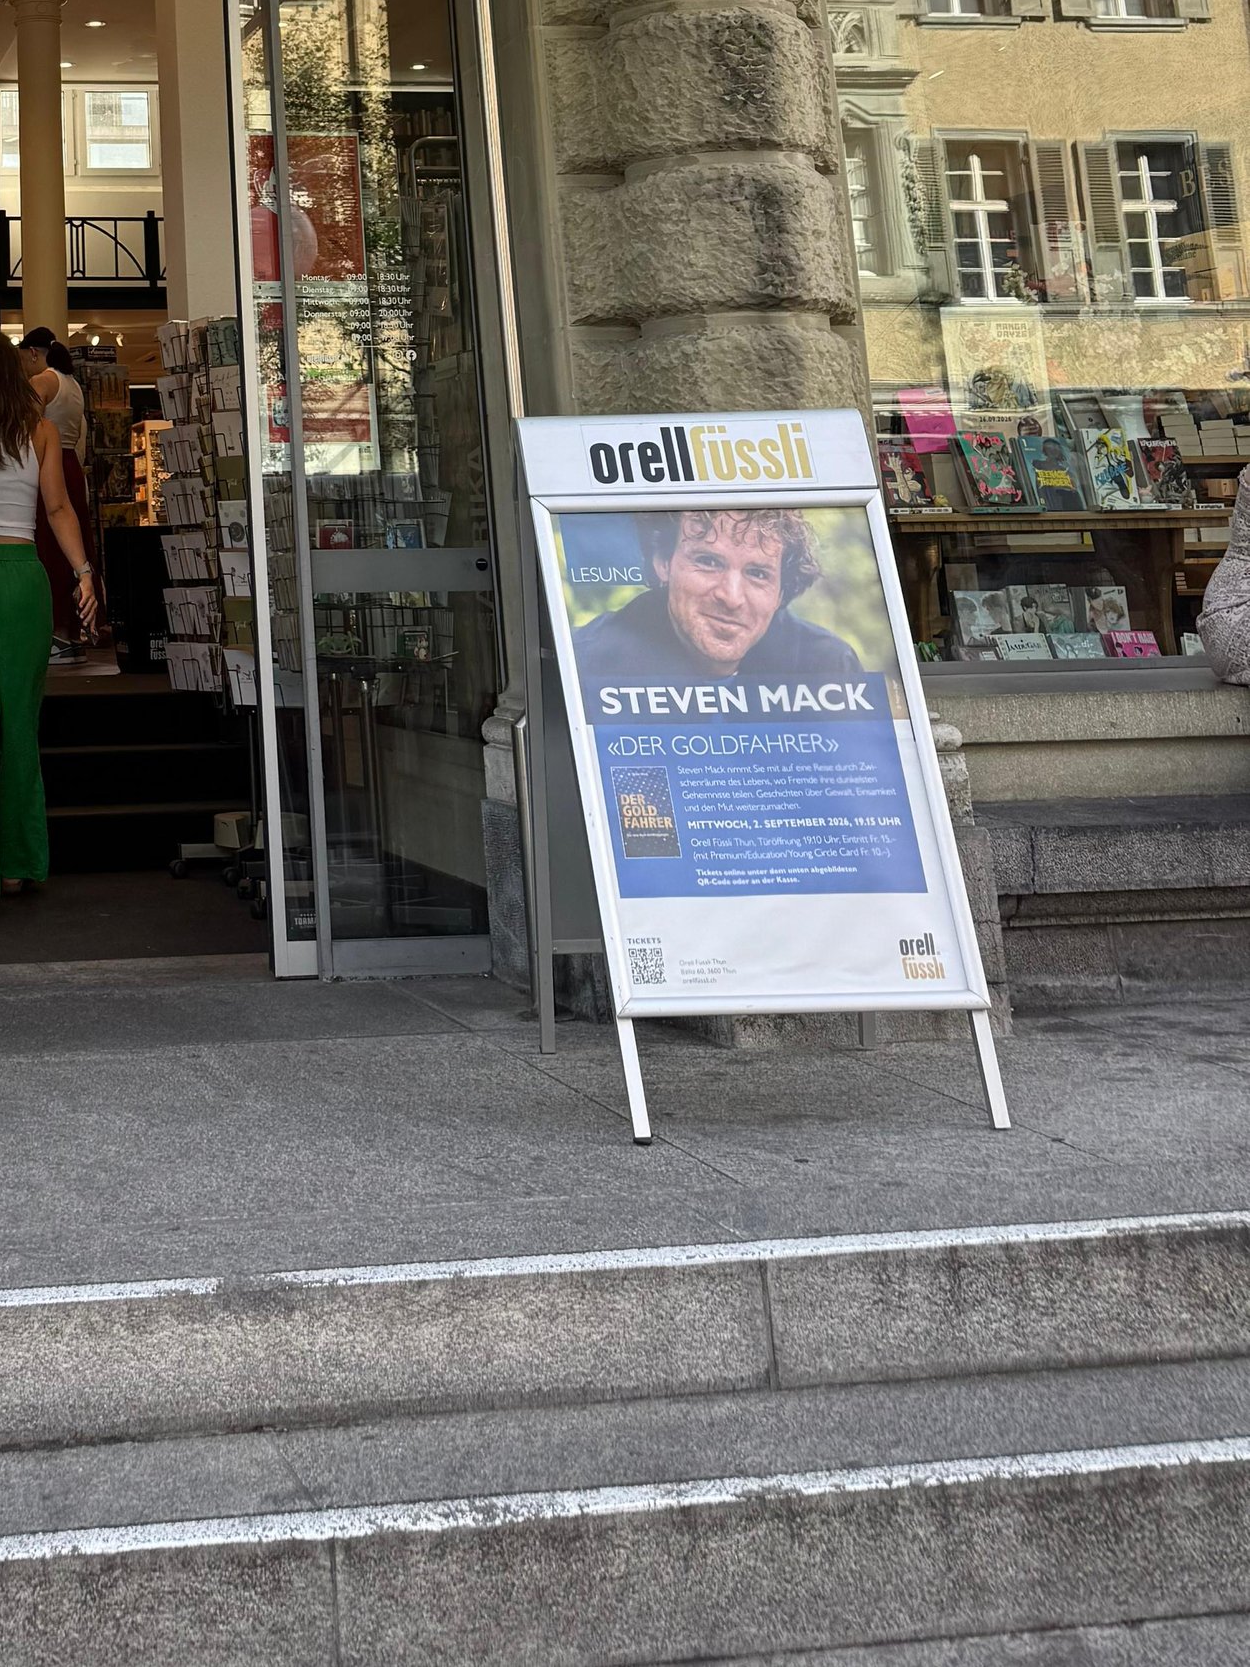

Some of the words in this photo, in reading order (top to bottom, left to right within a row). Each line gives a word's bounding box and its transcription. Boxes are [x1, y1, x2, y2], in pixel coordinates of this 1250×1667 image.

[378, 285, 396, 293] 18:30
[350, 309, 370, 317] 09:00
[399, 308, 413, 316] Uhr
[399, 320, 414, 328] Uhr
[400, 333, 415, 341] Uhr
[589, 423, 813, 484] orellfüssli
[571, 567, 642, 583] LESUNG
[600, 685, 749, 715] STEVEN
[759, 683, 874, 713] MACK
[607, 736, 666, 756] «DER
[671, 734, 839, 756] GOLDFAHRER»
[678, 765, 703, 775] Steven
[705, 765, 725, 774] Mack
[727, 764, 751, 773] nimmt
[754, 764, 766, 773] Sie
[767, 764, 780, 773] mit
[781, 763, 794, 773] auf
[835, 762, 859, 771] durch
[728, 777, 741, 786] des
[743, 777, 773, 787] Lebens,
[788, 775, 818, 785] Fremde
[756, 788, 804, 798] Geschichten
[805, 788, 822, 796] über
[621, 794, 646, 806] DER
[623, 805, 658, 817] GOLD
[684, 803, 700, 812] und
[701, 802, 716, 812] den
[717, 803, 734, 812] Mut
[624, 816, 673, 828] FAHRER
[687, 820, 752, 830] MITTWOCH,
[753, 820, 763, 829] 2.
[764, 818, 826, 828] SEPTEMBER
[828, 817, 853, 827] 2026,
[854, 816, 876, 826] 19.15
[878, 816, 902, 826] UHR
[690, 838, 711, 847] Orell
[713, 838, 733, 847] Füssli
[734, 838, 757, 847] Thun,
[823, 835, 841, 845] Uhr,
[870, 834, 880, 843] Fr.
[693, 851, 709, 862] (mit
[814, 848, 838, 857] Circle
[839, 847, 859, 857] Card
[860, 847, 870, 856] Fr.
[695, 868, 722, 877] Tickets
[723, 868, 746, 876] online
[747, 868, 767, 876] unter
[769, 867, 786, 875] dem
[810, 865, 858, 875] abgebildeten
[697, 879, 731, 887] QR-Code
[732, 878, 749, 886] oder
[762, 877, 775, 885] der
[776, 876, 800, 884] Kasse.
[627, 937, 662, 945] TICKETS
[899, 932, 936, 956] orell
[901, 955, 946, 980] füssli
